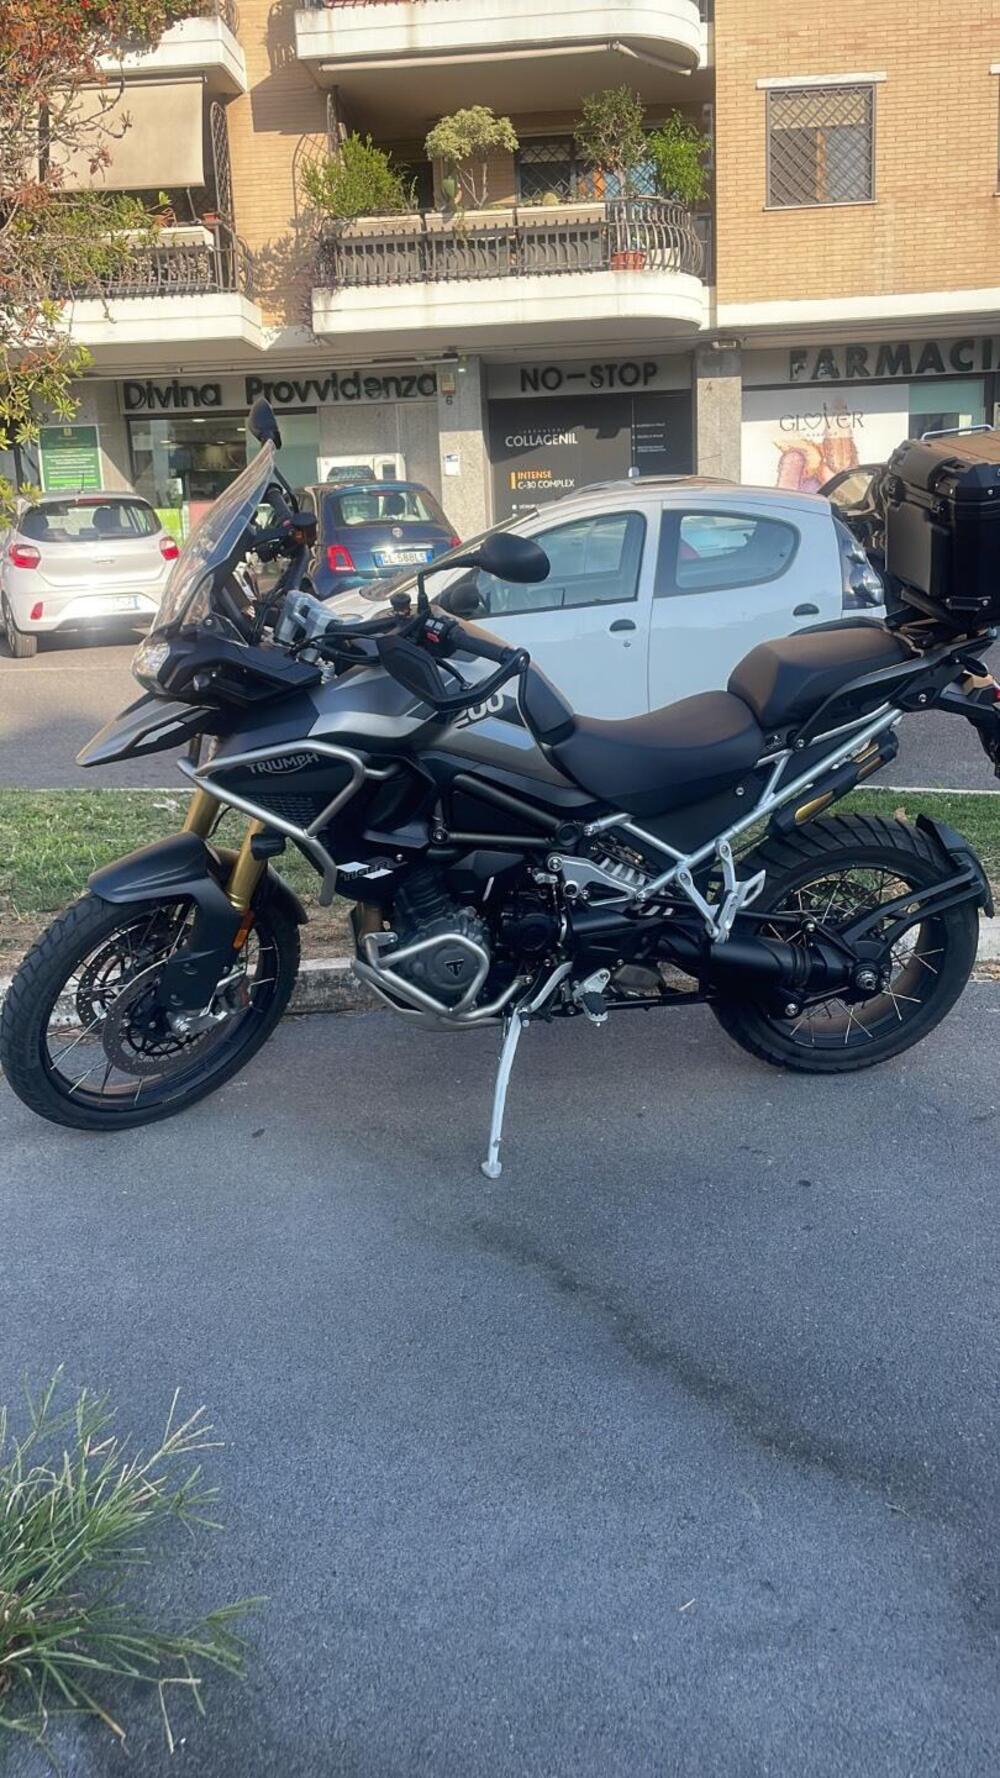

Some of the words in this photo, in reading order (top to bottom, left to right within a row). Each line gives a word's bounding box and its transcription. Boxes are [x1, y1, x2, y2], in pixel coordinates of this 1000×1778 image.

[789, 338, 1000, 382] FARMACI
[123, 379, 222, 410] Divina
[245, 371, 438, 405] Provvidenza
[505, 432, 578, 447] COLLAGENIL
[518, 469, 552, 480] INTENSE
[518, 480, 537, 490] C-30
[537, 478, 575, 489] COMPLEX
[246, 753, 320, 774] TRIUMPH
